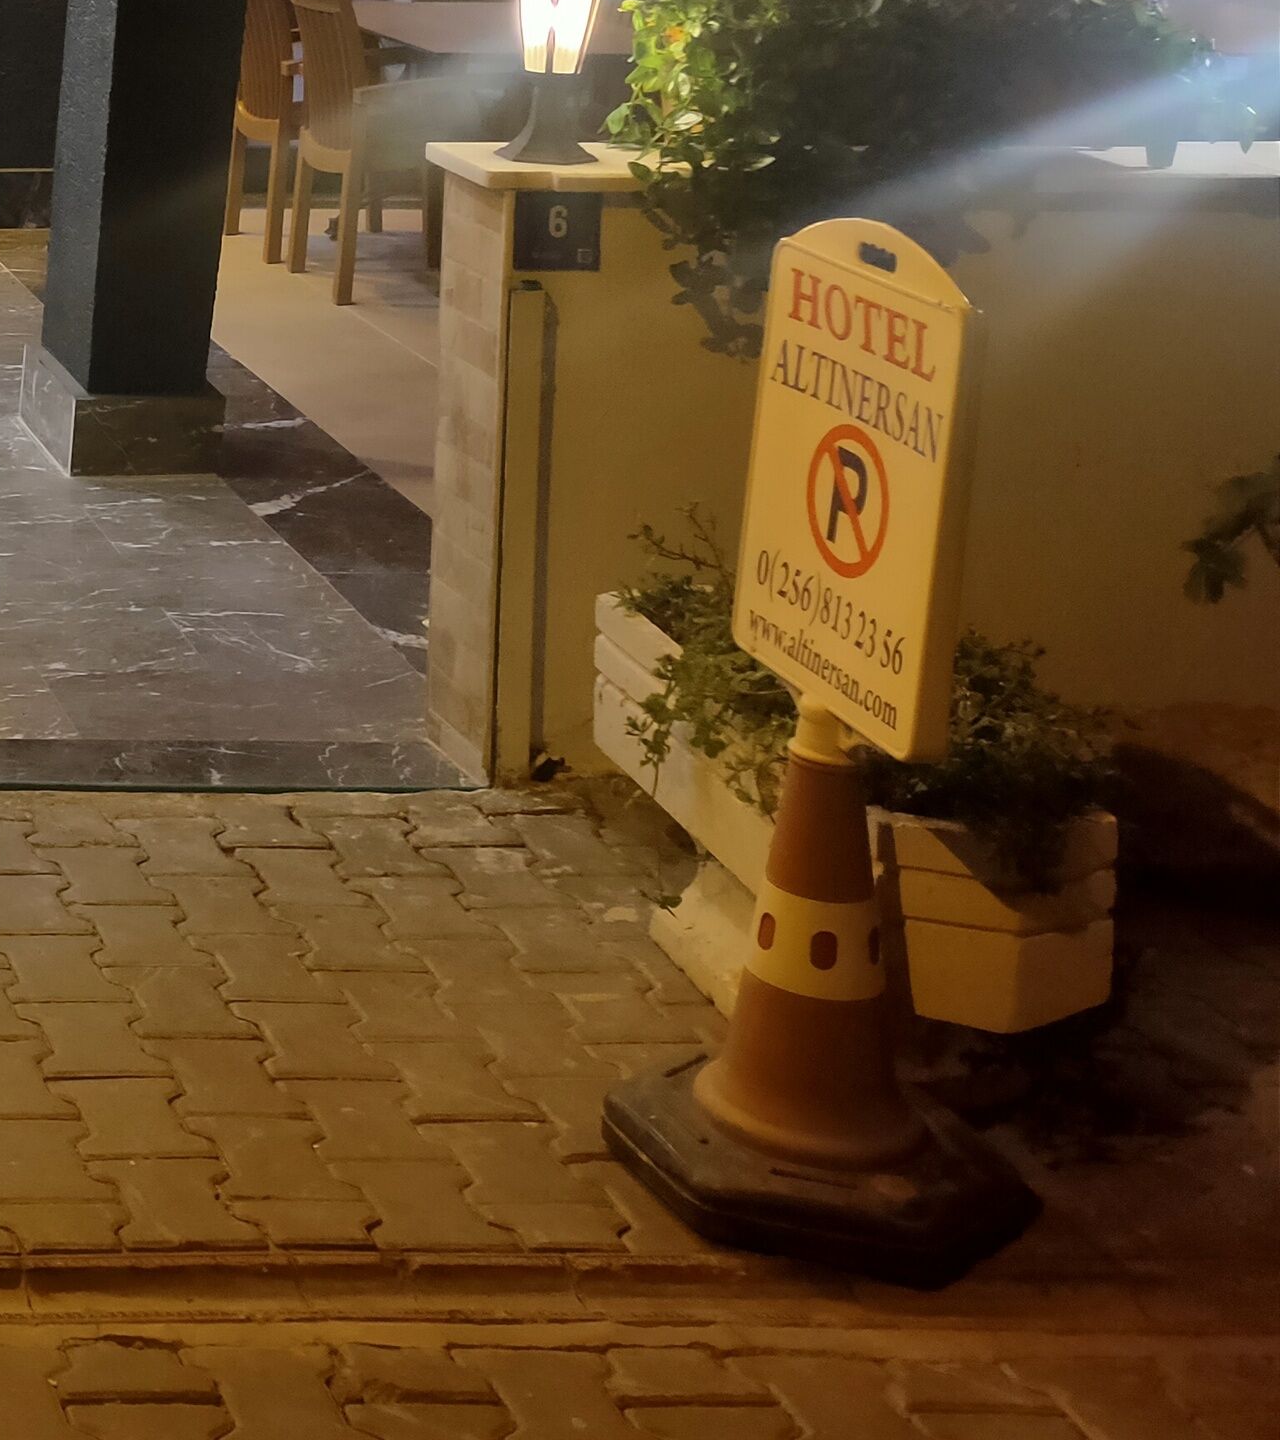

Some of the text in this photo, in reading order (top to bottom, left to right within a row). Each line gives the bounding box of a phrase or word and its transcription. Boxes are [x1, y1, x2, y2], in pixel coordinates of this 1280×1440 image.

[548, 205, 569, 239] 6
[788, 267, 937, 382] HOTEL
[770, 338, 945, 464] ALTINERSAN
[749, 609, 898, 732] www.altinersan.com
